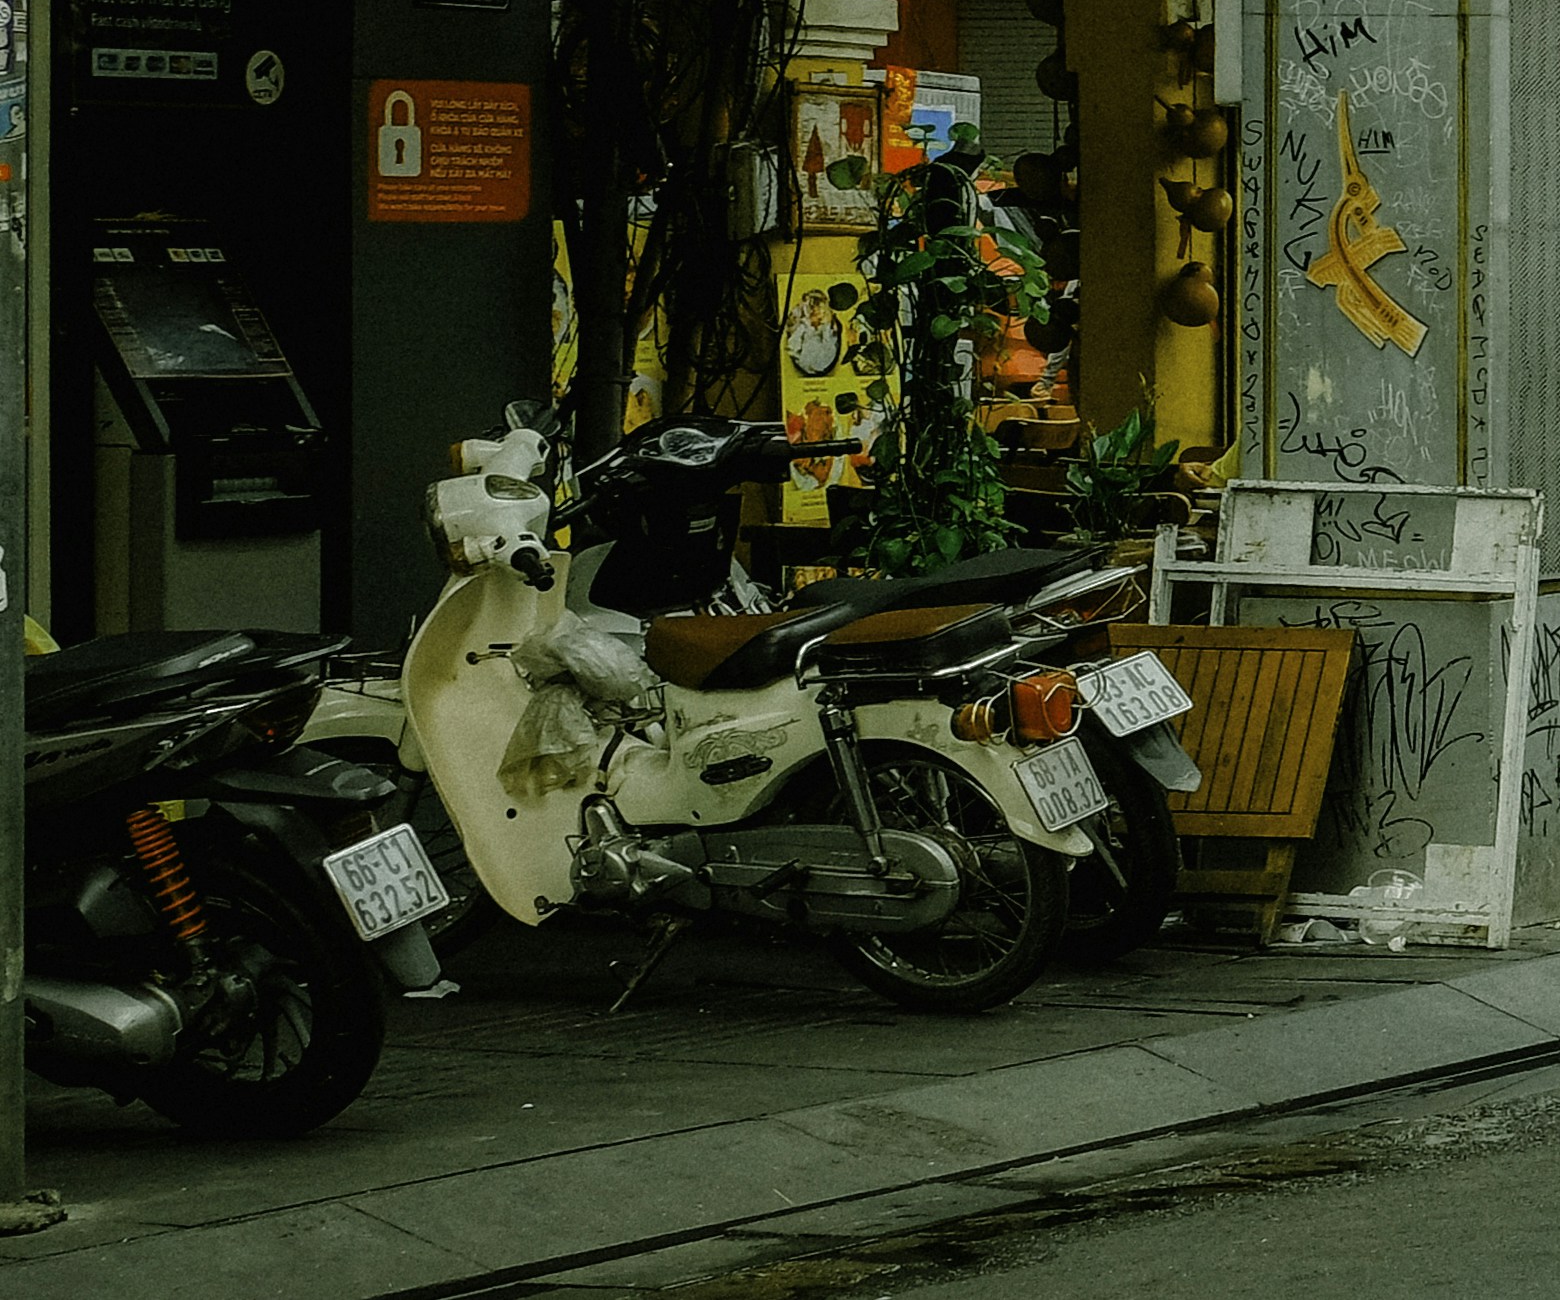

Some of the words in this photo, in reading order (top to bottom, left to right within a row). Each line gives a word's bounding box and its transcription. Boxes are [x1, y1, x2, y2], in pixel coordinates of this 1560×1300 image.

[1105, 684, 1184, 731] 163.08
[1038, 776, 1101, 825] 008.32
[354, 869, 440, 931] 632.52
